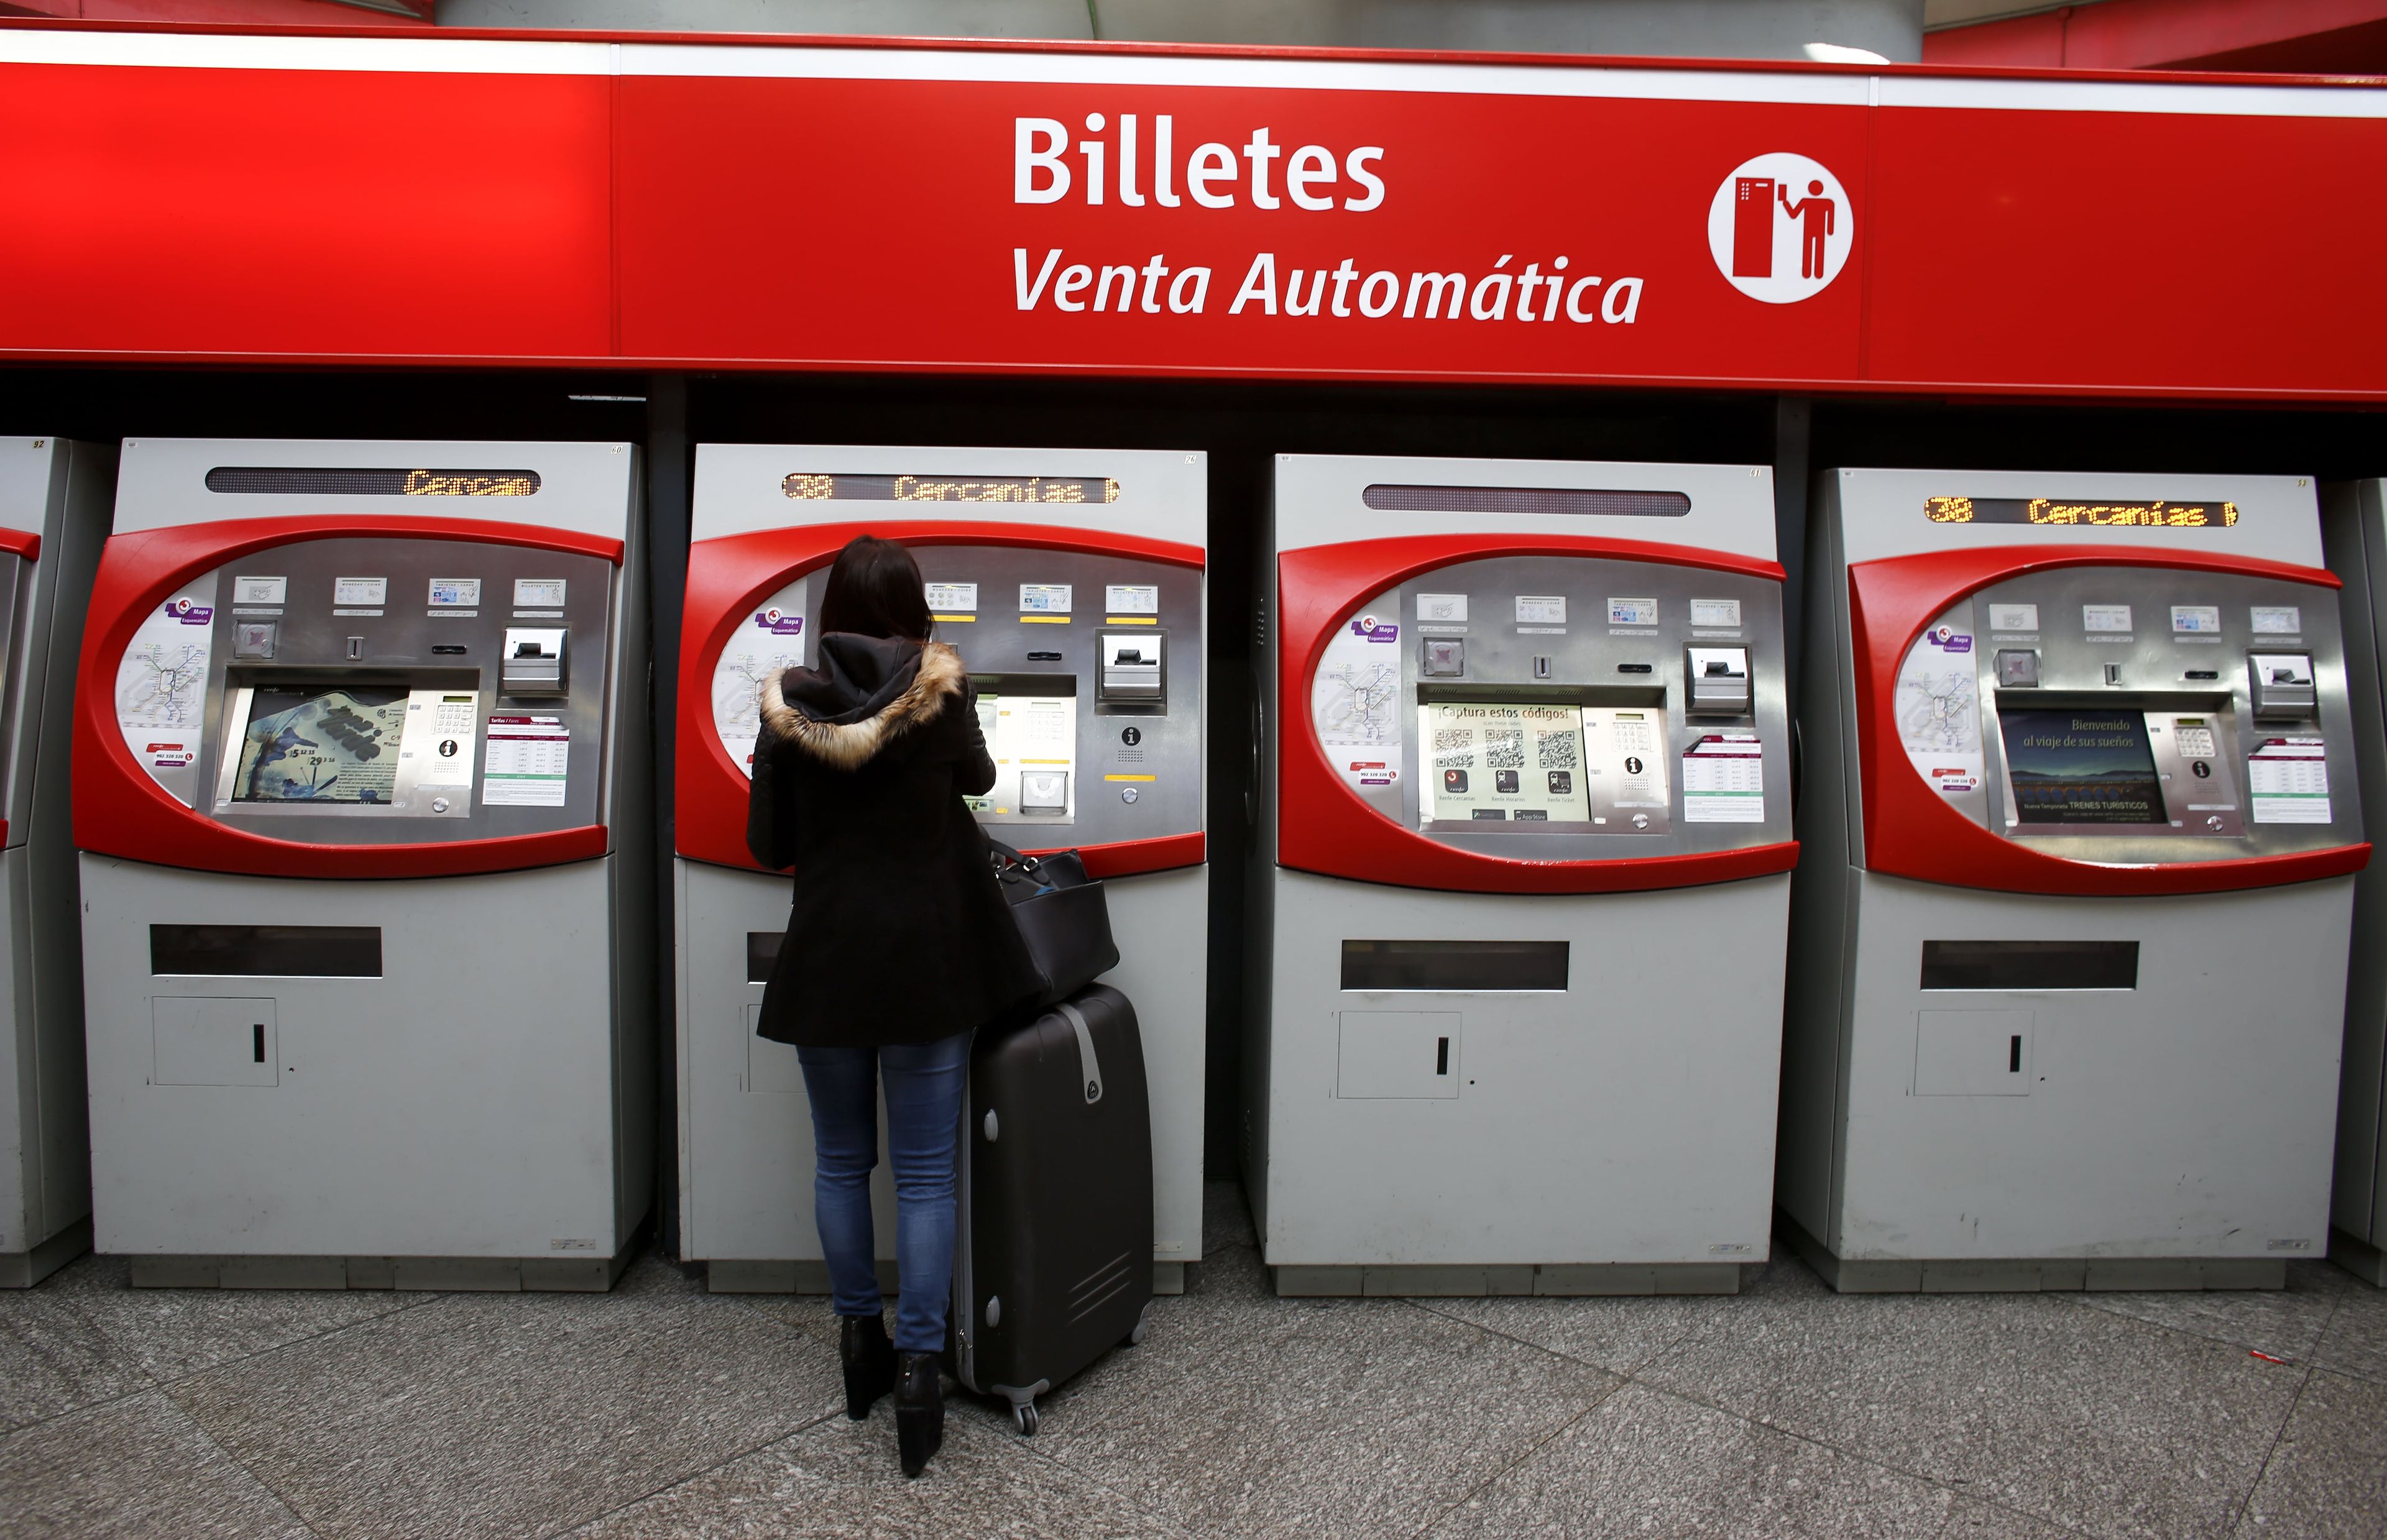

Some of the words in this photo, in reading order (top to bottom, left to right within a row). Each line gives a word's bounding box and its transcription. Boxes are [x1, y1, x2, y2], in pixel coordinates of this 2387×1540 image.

[1014, 112, 1386, 212] Billetes
[1013, 248, 1212, 314] Venta
[1228, 252, 1644, 324] Automática
[33, 440, 44, 449] 92
[894, 475, 1085, 503] Cercanías
[2029, 498, 2209, 527] Cercanías
[1379, 625, 1394, 633] Mapa
[1954, 636, 1968, 644] Mapa
[1438, 705, 1486, 720] ¡Captura
[1489, 708, 1519, 718] estos
[1522, 707, 1569, 721] códigos!
[2072, 719, 2130, 731] Bienvenido
[2023, 735, 2034, 746] al
[2036, 736, 2061, 750] viaje
[2063, 735, 2076, 747] de
[2079, 738, 2095, 747] sus
[2098, 736, 2133, 747] sueños
[310, 756, 322, 766] 29
[2069, 802, 2100, 810] TRENES
[2102, 800, 2148, 810] TURÍSTICOS
